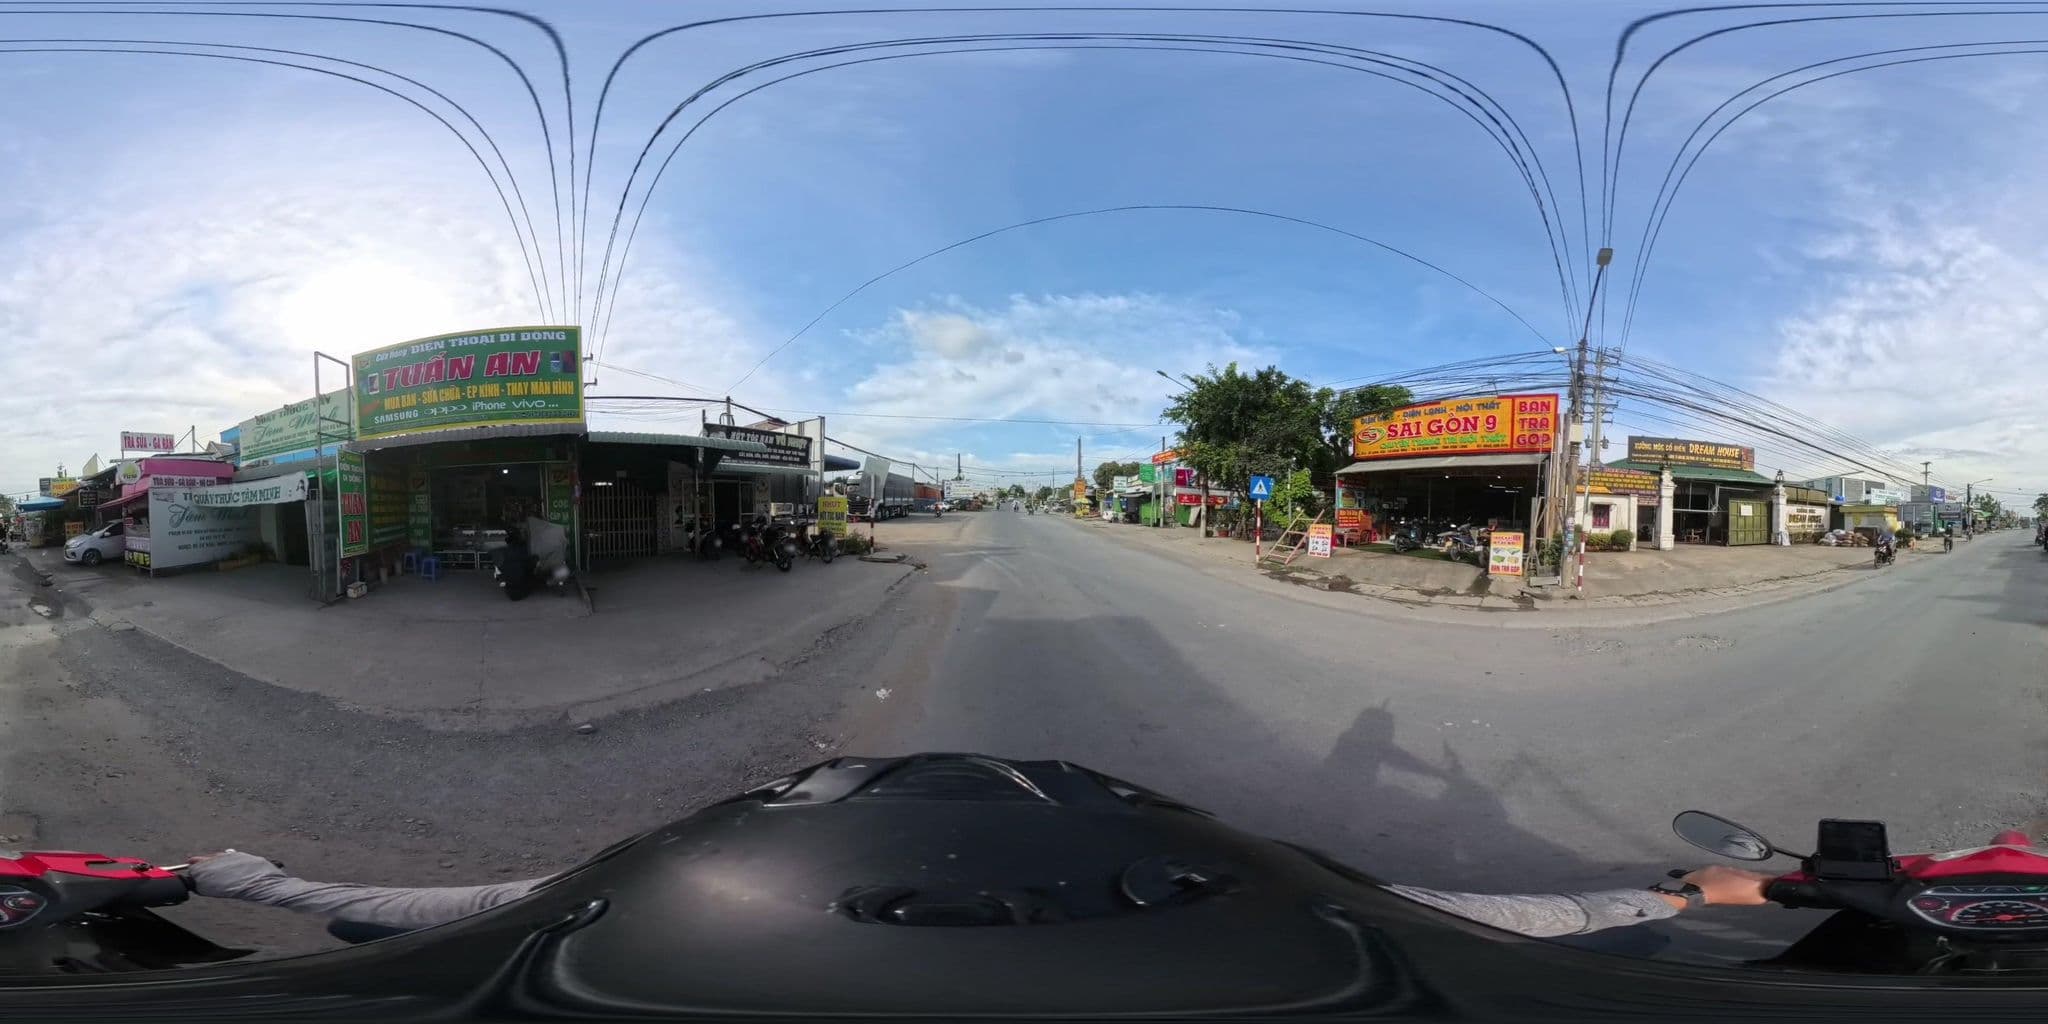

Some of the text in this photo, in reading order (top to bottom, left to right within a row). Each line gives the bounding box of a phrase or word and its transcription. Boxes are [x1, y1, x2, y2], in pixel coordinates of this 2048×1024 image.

[448, 334, 495, 347] THOẠI
[500, 333, 516, 342] DI
[521, 331, 566, 343] ĐỘNG
[483, 349, 542, 377] AN
[506, 381, 529, 396] THAY
[374, 409, 419, 424] SAMSUNG
[472, 401, 507, 411] iPhone
[511, 399, 546, 408] vivo
[1485, 414, 1497, 432] 9
[1689, 443, 1715, 456] DREAM
[1717, 446, 1740, 458] HOUSE
